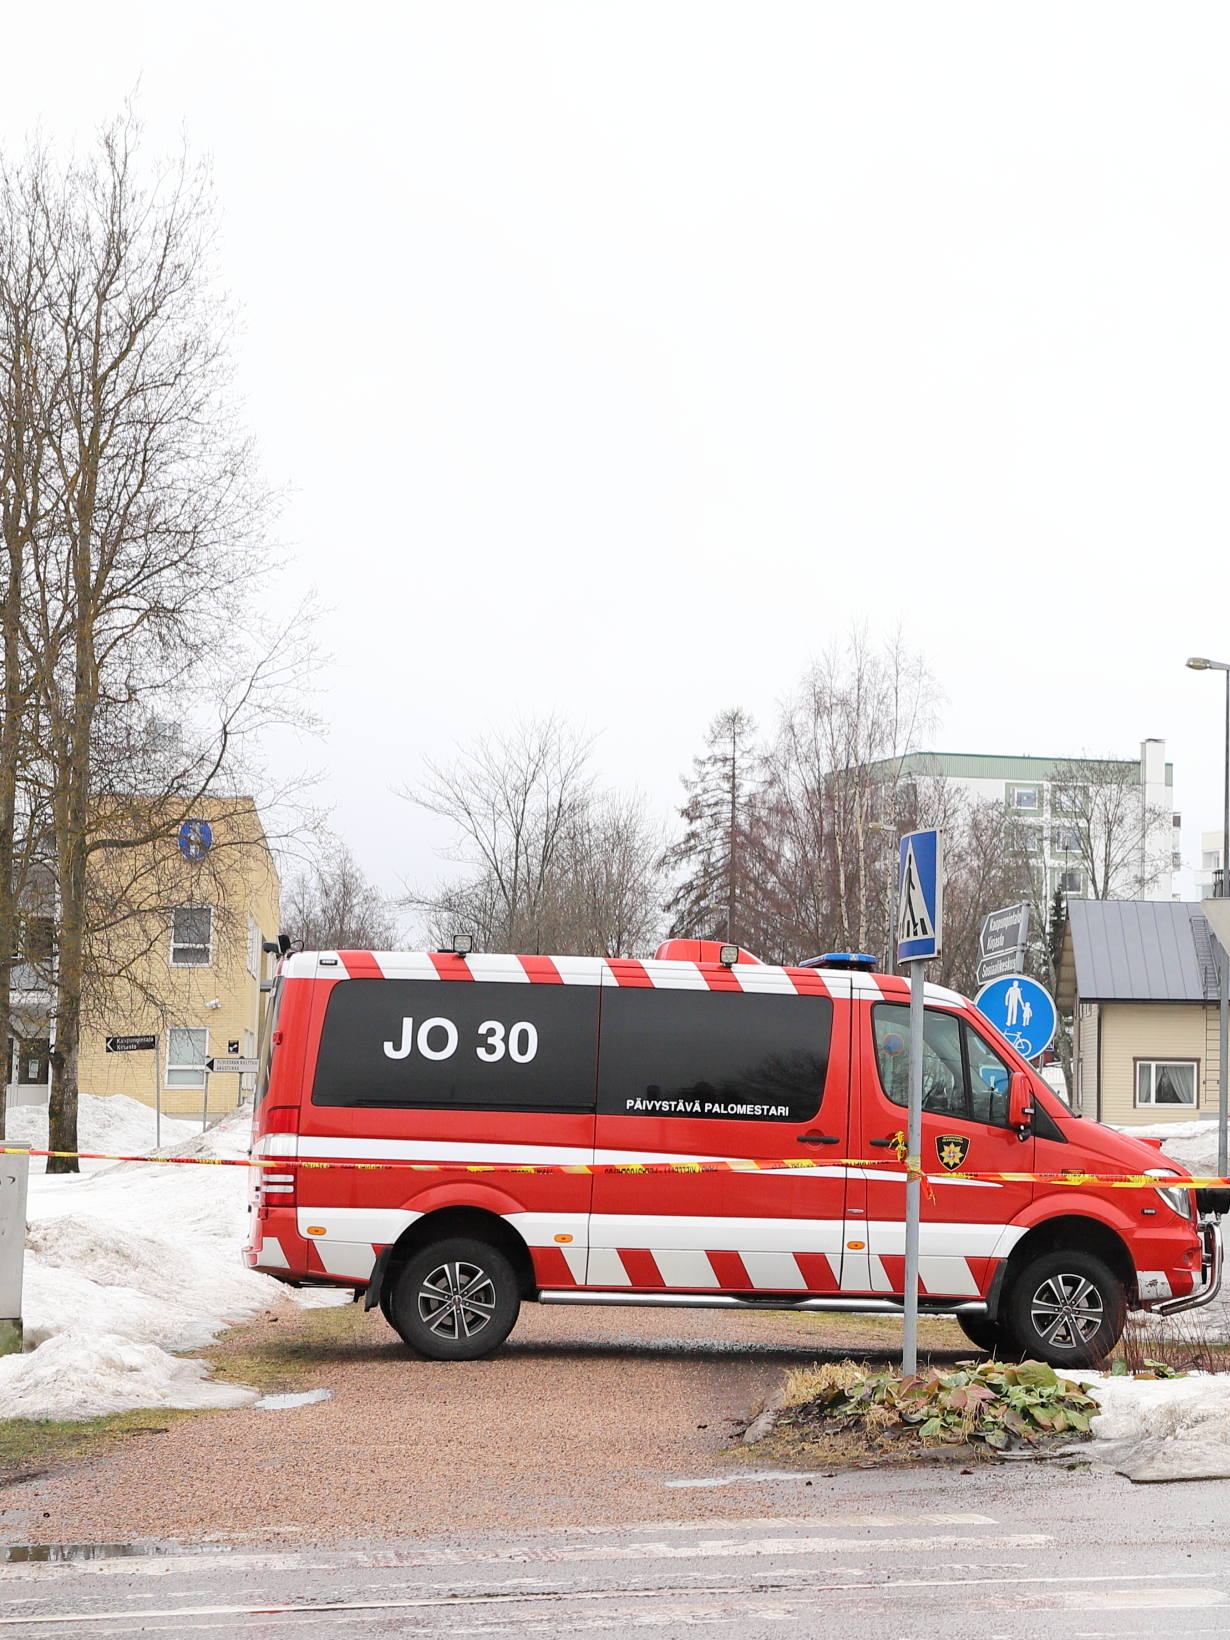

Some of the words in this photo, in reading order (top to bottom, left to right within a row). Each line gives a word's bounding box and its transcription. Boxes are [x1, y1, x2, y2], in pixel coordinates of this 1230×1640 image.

[989, 909, 1021, 932] Kaupungintalo
[986, 933, 1005, 951] Kirjasto
[981, 956, 1016, 978] Sosiaalikeskus
[383, 1016, 459, 1061] JO
[476, 1020, 539, 1064] 30
[625, 1097, 702, 1113] PÄIVYSTÄVÄ
[704, 1102, 790, 1117] PALOMESTARI
